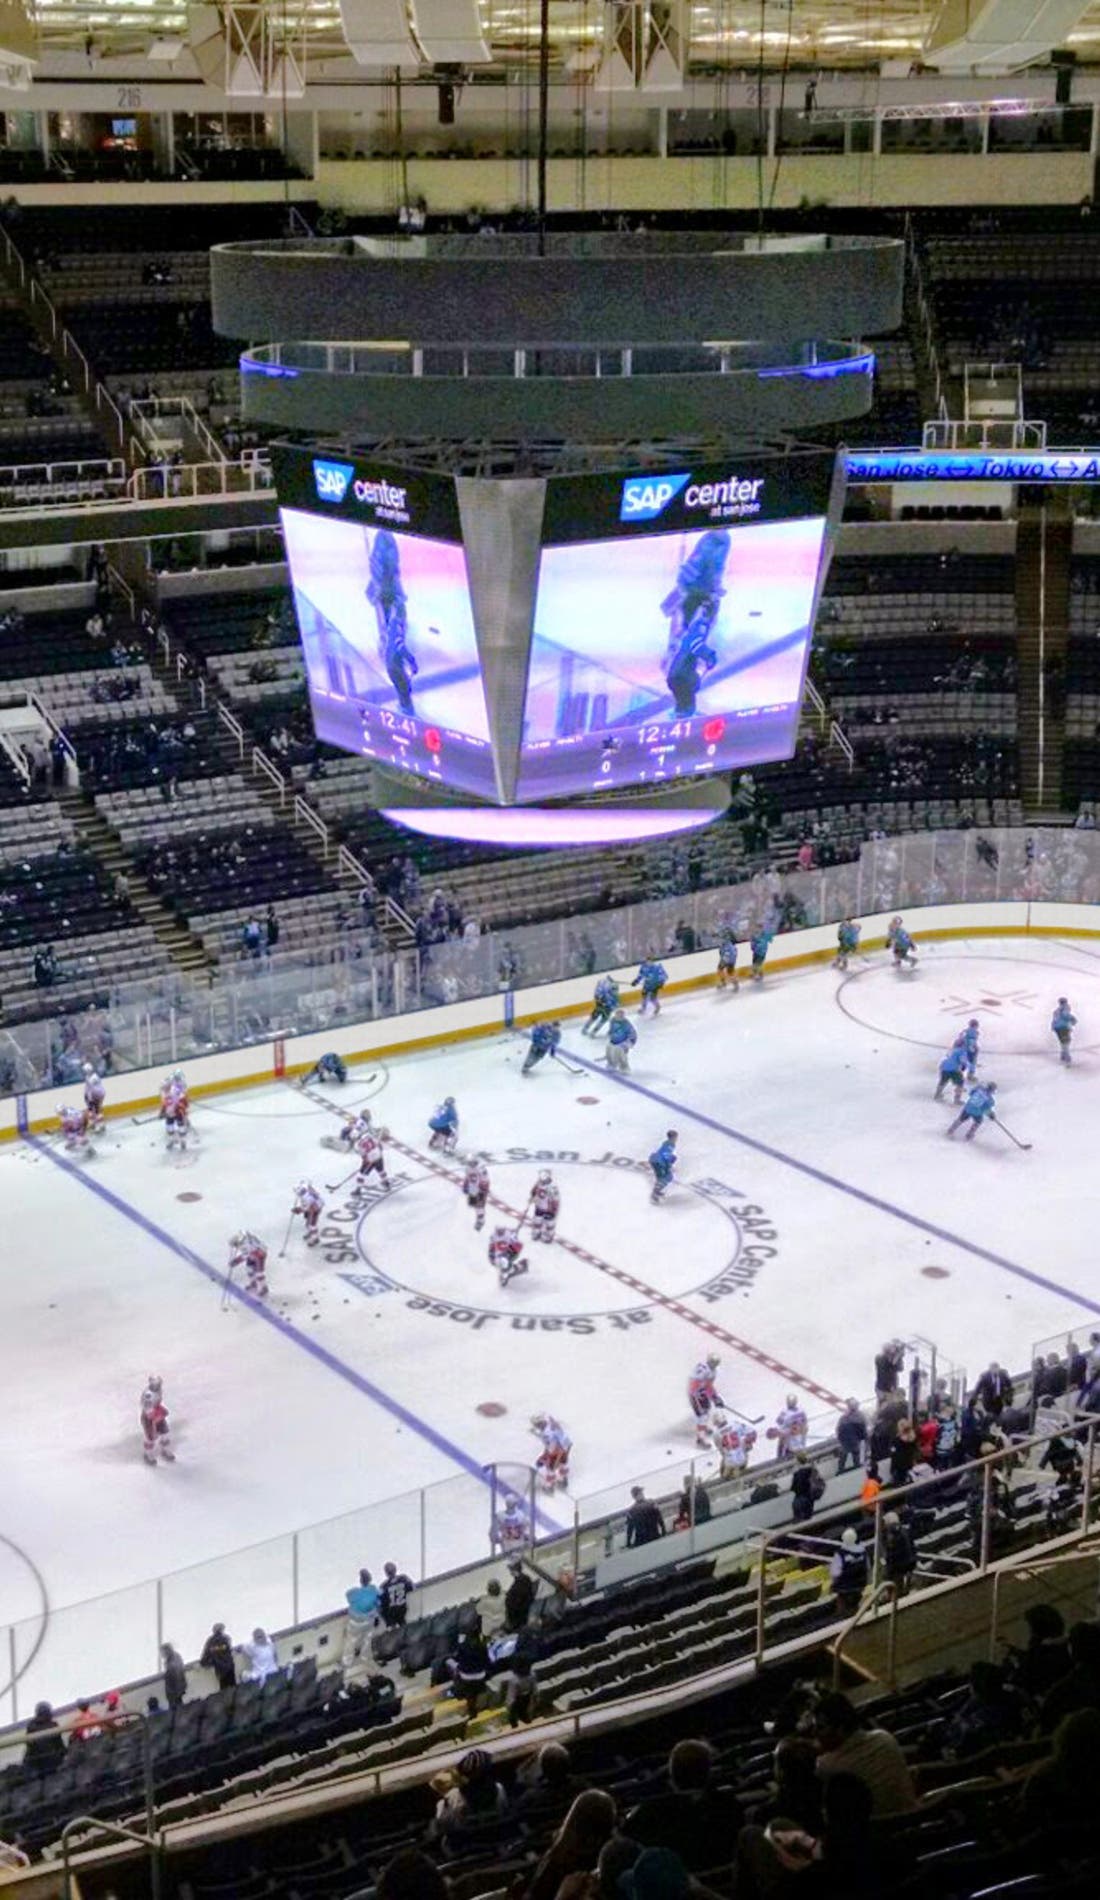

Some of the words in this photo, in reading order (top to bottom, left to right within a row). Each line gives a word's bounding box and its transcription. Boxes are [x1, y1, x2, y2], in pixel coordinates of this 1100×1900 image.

[886, 459, 938, 478] Jose
[980, 458, 1045, 478] Tokyo
[315, 467, 347, 495] SAP
[353, 479, 407, 509] center
[624, 484, 673, 512] SAP
[684, 476, 765, 507] center
[638, 721, 692, 744] 12:41
[601, 760, 611, 773] 0
[506, 1147, 580, 1161] San
[590, 1151, 651, 1174] Jos
[729, 1204, 778, 1241] SAP
[320, 1226, 359, 1264] SAP
[699, 1245, 778, 1303] Center
[406, 1296, 500, 1330] Jose
[511, 1316, 596, 1335] San
[607, 1309, 653, 1330] at
